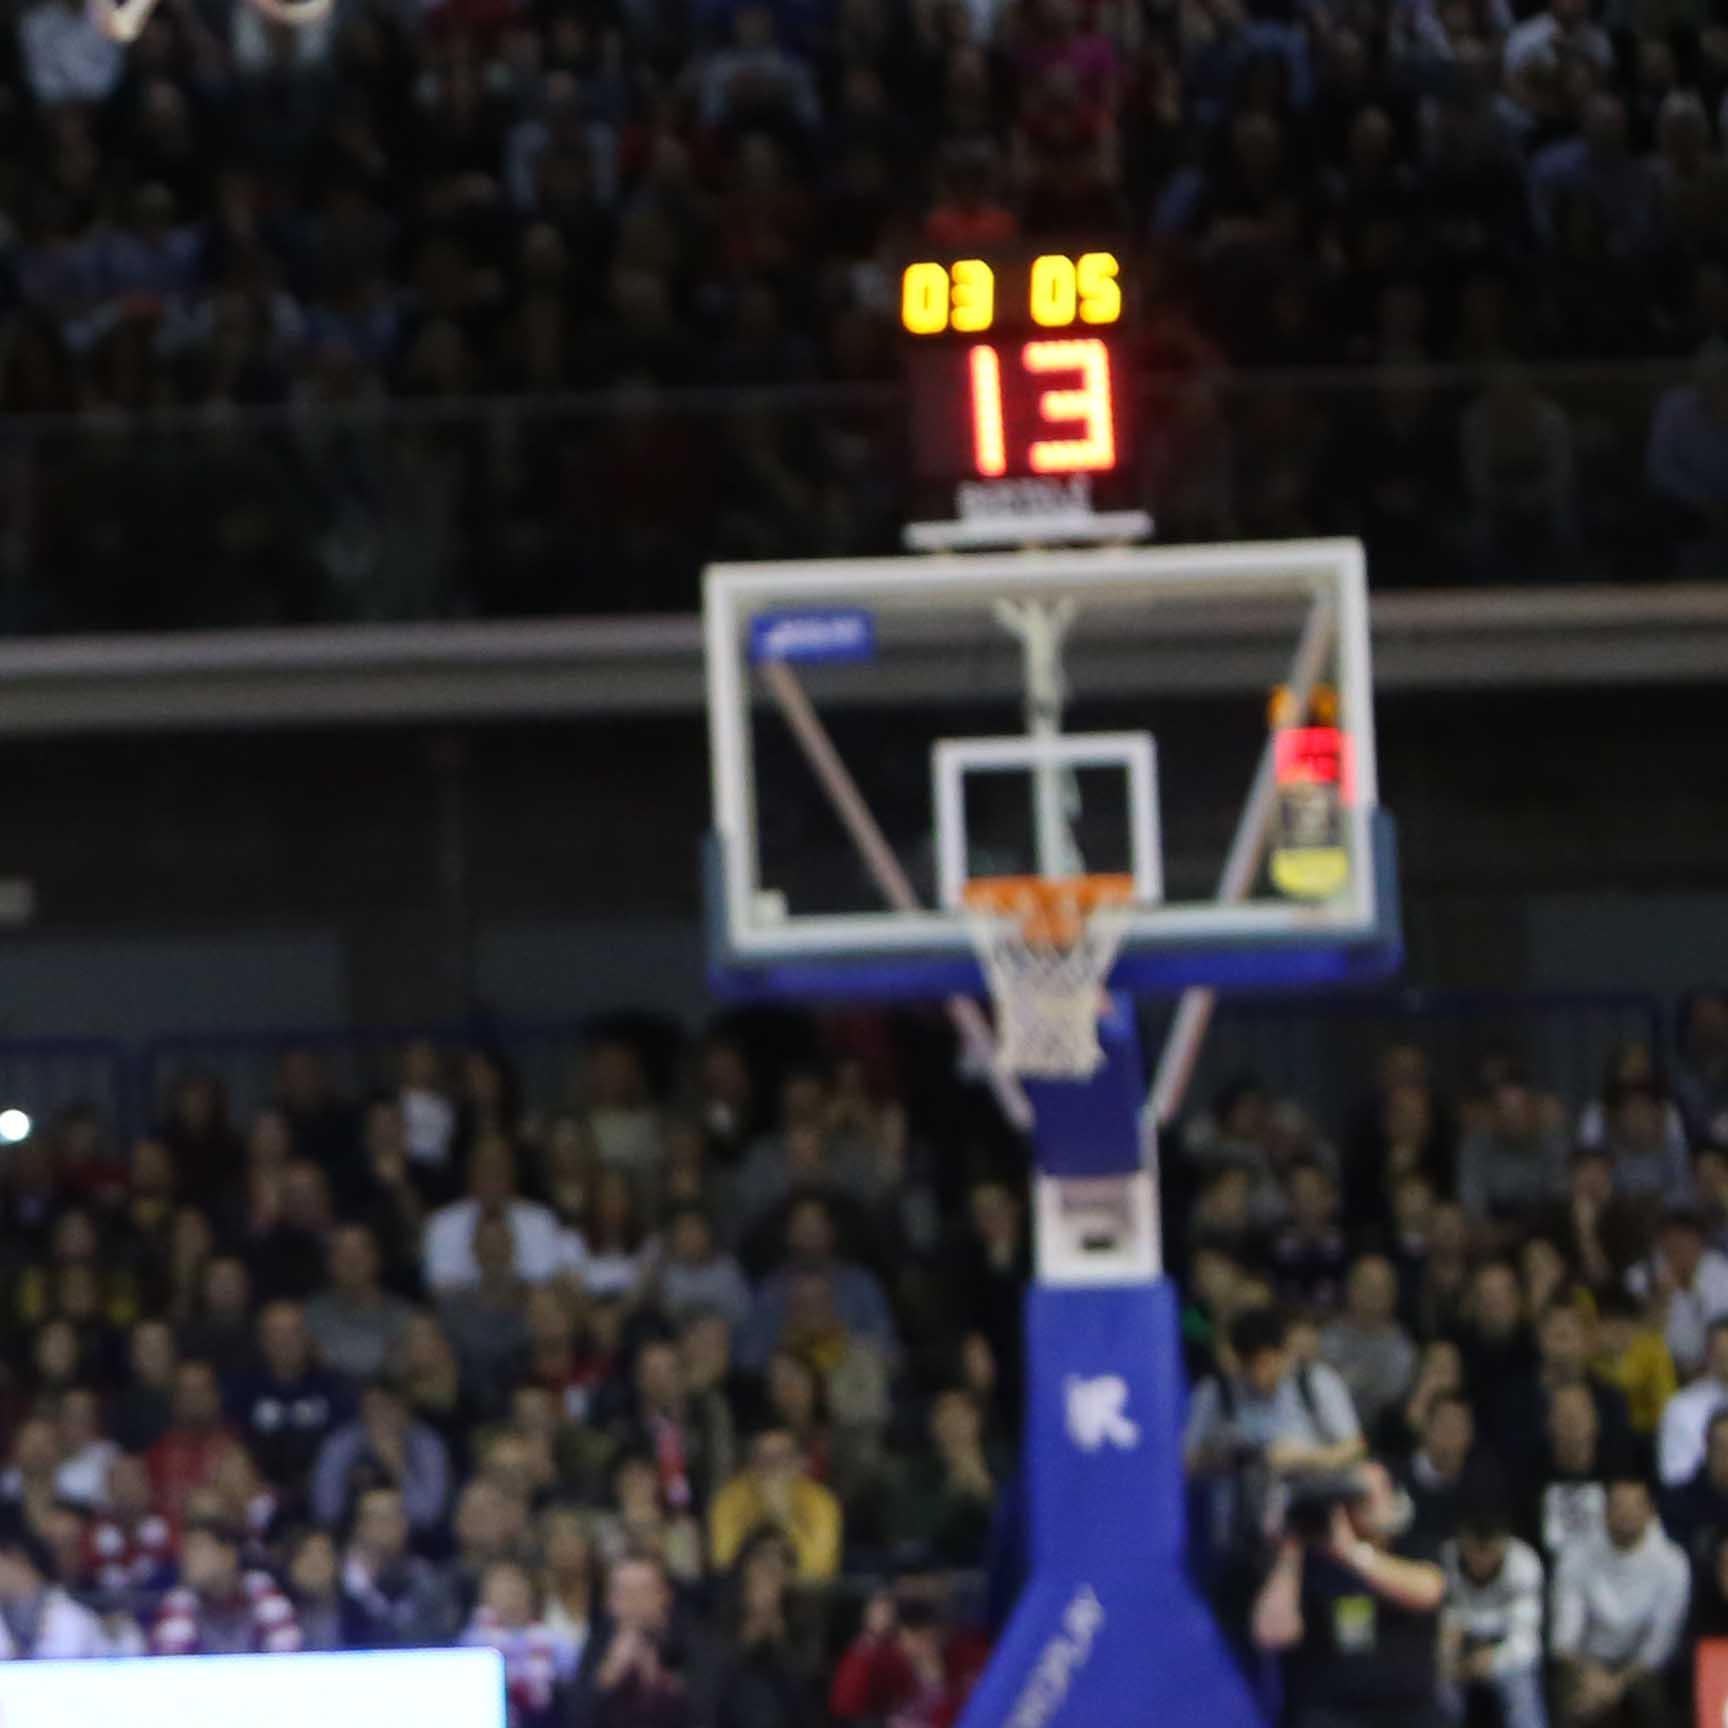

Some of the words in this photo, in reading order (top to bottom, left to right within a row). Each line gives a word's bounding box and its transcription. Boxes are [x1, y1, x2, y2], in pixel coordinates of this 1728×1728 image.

[902, 260, 994, 334] 03
[1030, 252, 1121, 326] 05
[971, 338, 1115, 475] 13
